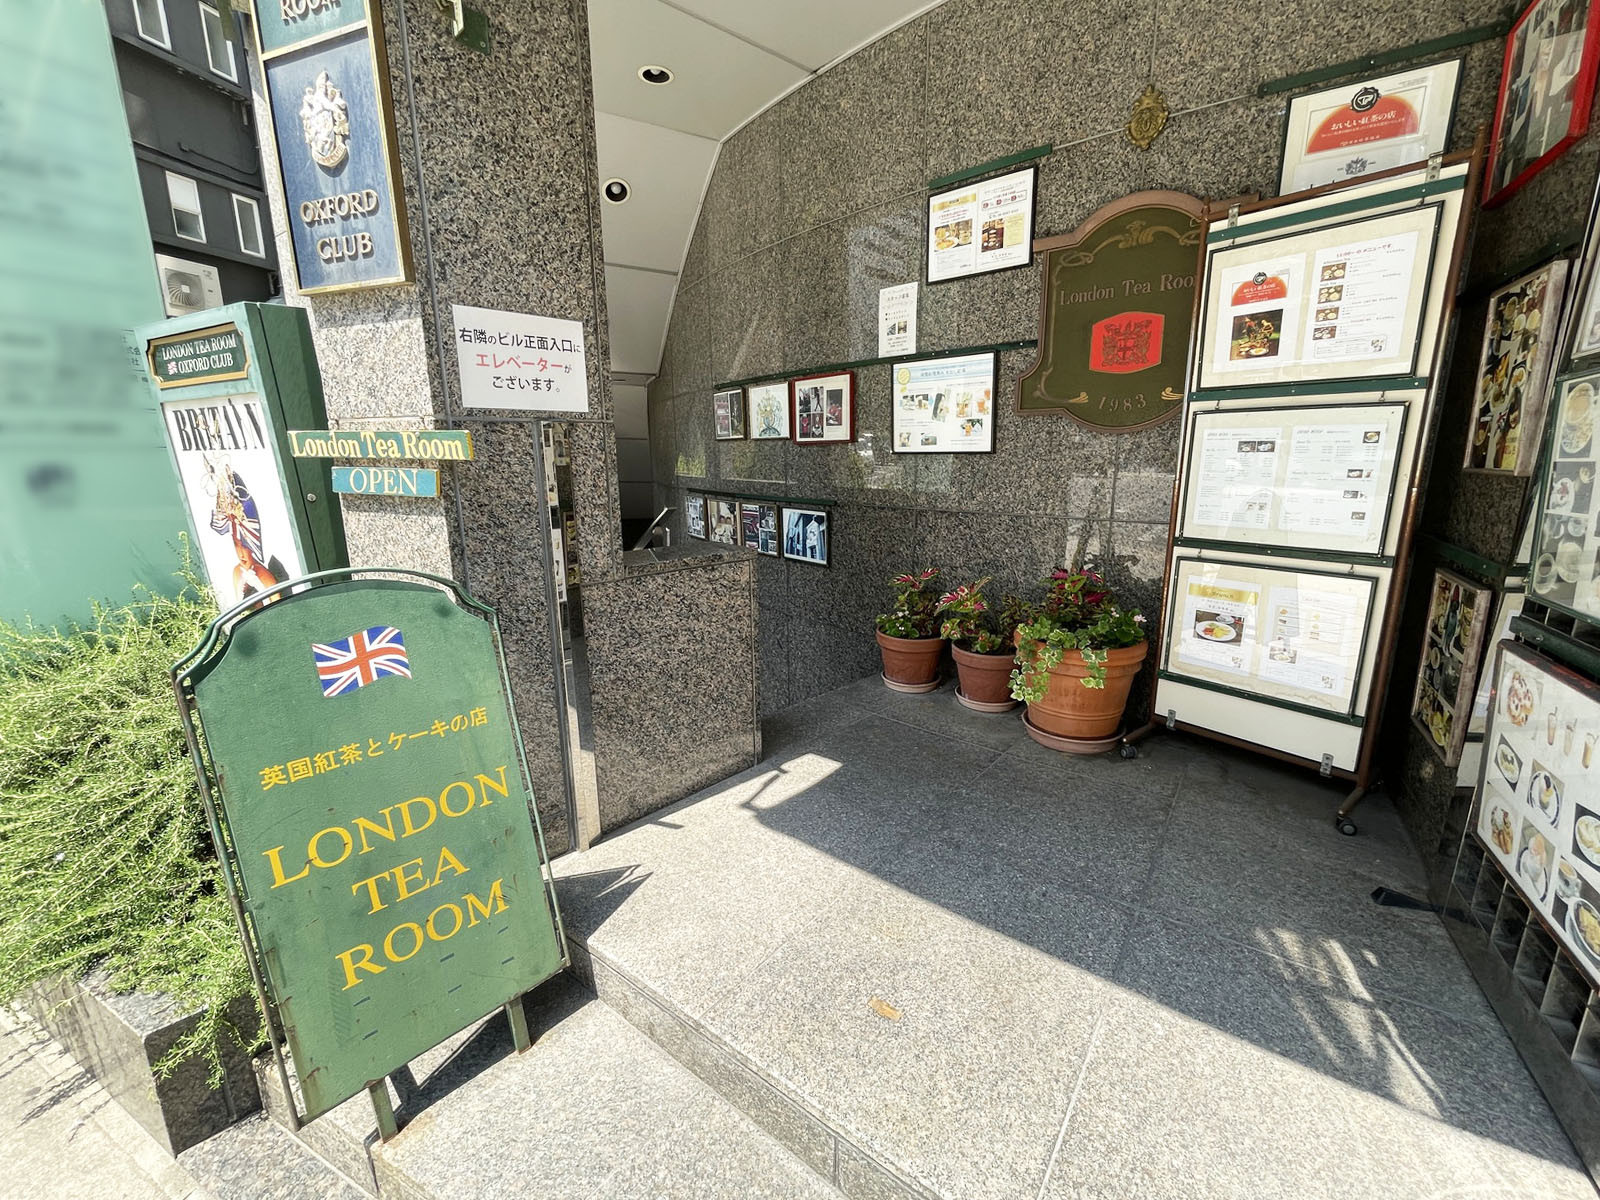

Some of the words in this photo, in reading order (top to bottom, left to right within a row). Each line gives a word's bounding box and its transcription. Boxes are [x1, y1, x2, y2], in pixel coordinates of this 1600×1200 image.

[300, 189, 379, 223] OXFORD
[317, 232, 373, 259] CLUB
[1059, 284, 1115, 306] London
[1122, 279, 1152, 299] Tea
[1160, 273, 1196, 293] Roo
[161, 342, 194, 361] LONDON
[194, 339, 211, 355] TEA
[211, 333, 237, 352] ROOM
[459, 328, 581, 353] 右隣のビル正面入口に
[178, 356, 210, 374] OXFORD
[210, 352, 234, 369] CLUB
[475, 353, 573, 374] エレベーターが
[492, 375, 561, 393] ございます。
[1099, 393, 1147, 412] 1983
[290, 431, 362, 458] London
[360, 431, 401, 459] Tea
[400, 431, 466, 460] Room
[349, 467, 419, 495] OPEN
[258, 706, 489, 791] 英国紅茶とケーキの店
[262, 765, 510, 889] LONDON
[351, 846, 471, 916] TEA
[334, 878, 511, 991] ROOM
